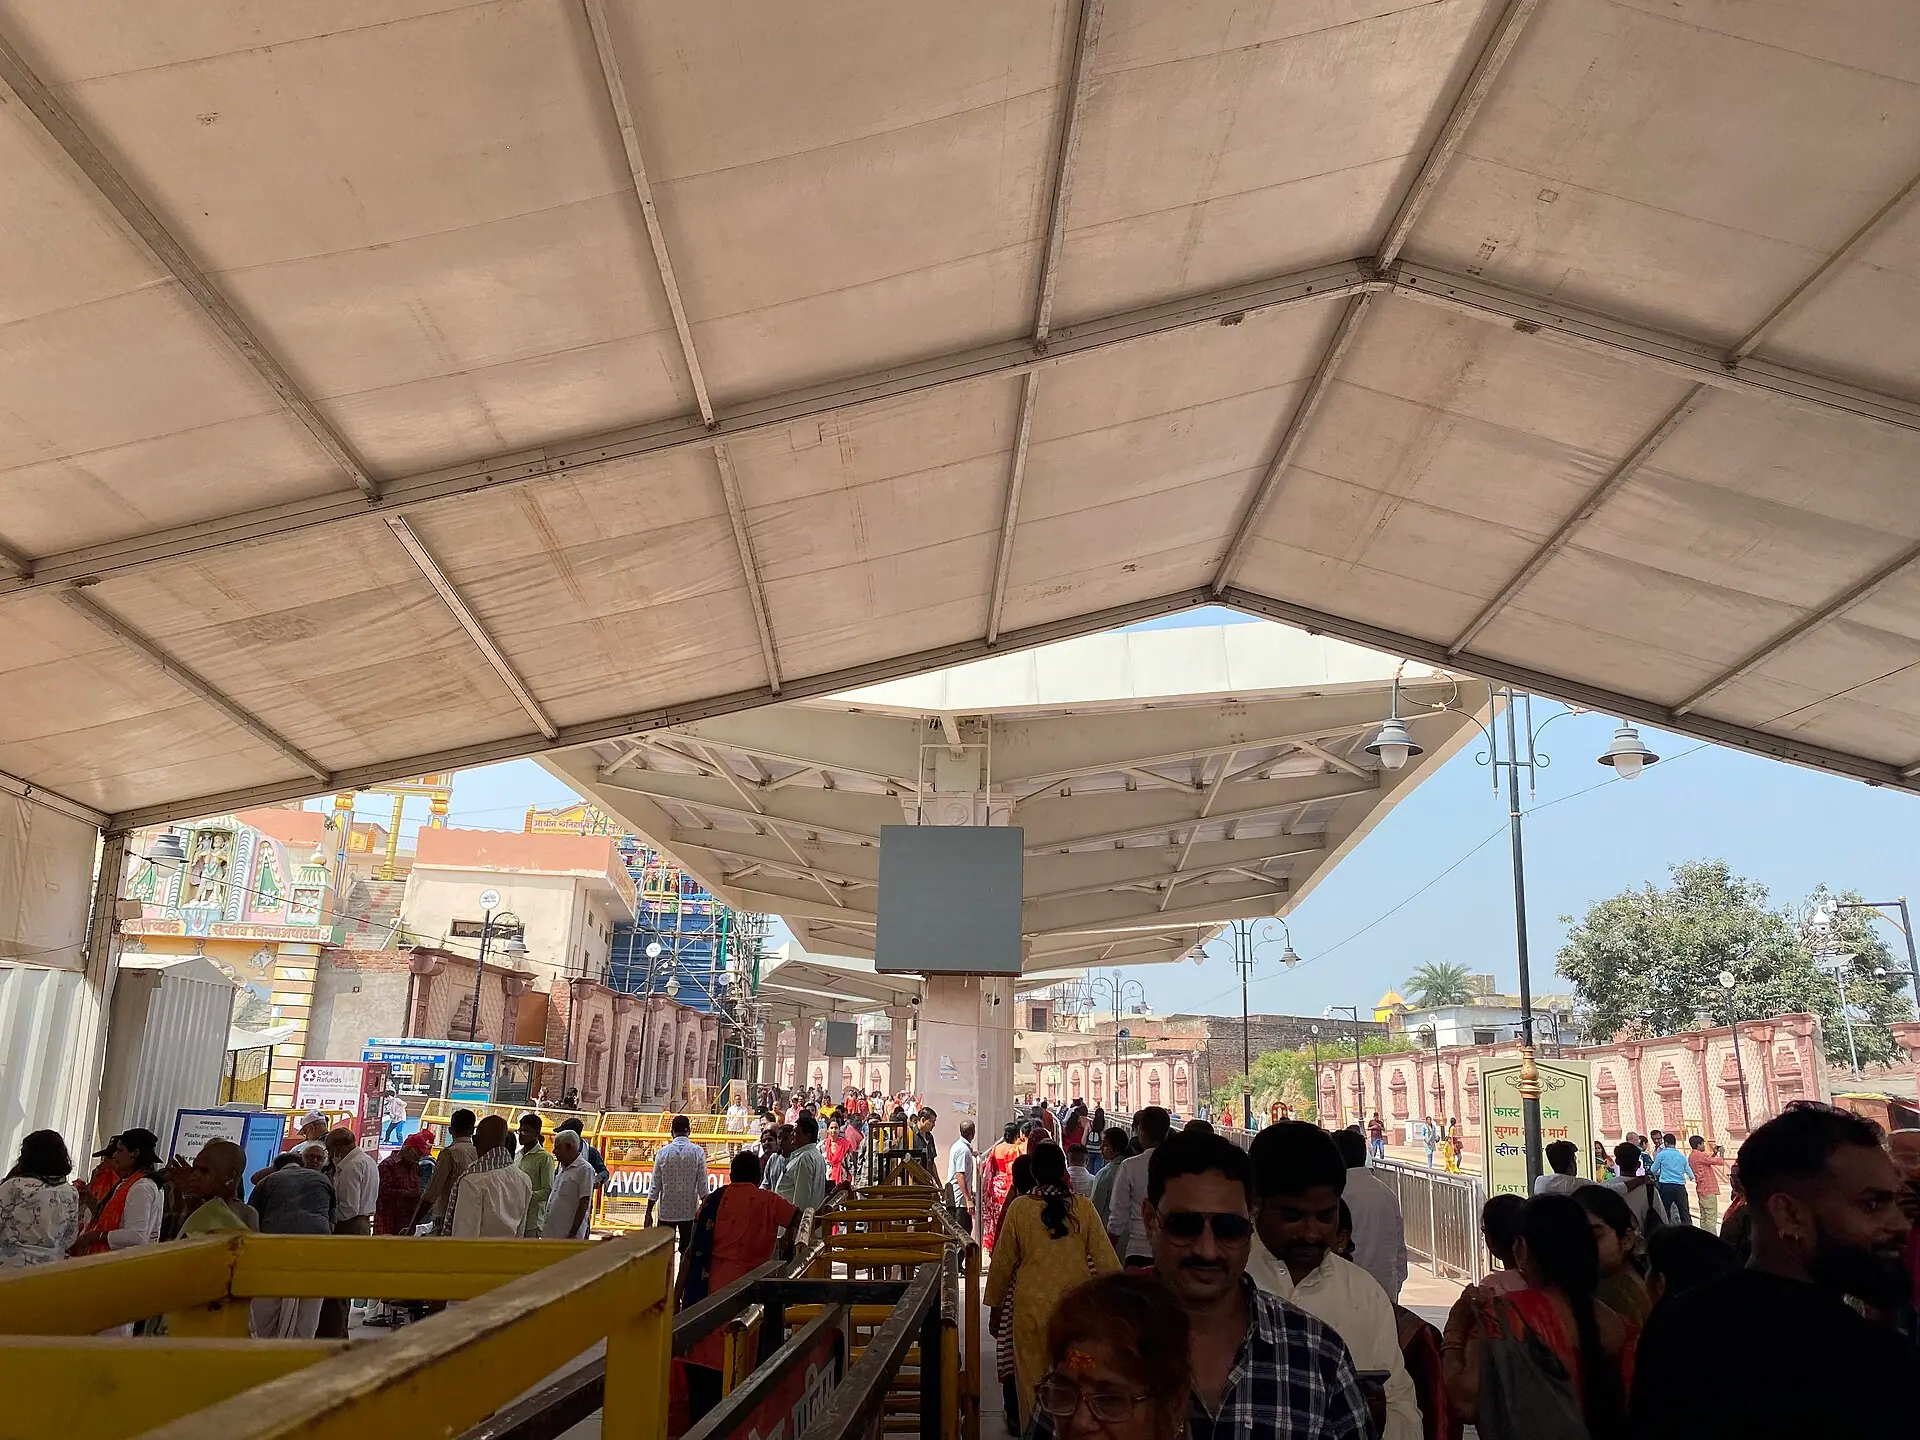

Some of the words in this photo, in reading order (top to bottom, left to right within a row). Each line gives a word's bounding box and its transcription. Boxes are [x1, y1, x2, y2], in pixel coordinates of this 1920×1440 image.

[473, 1056, 485, 1066] LIC
[1493, 1107, 1520, 1118] फास्ट
[1542, 1106, 1559, 1119] लेन
[1494, 1126, 1519, 1139] सुगम
[1548, 1125, 1568, 1138] मार्ग
[1494, 1143, 1519, 1156] व्हील
[607, 1171, 653, 1193] AYOD
[1496, 1184, 1518, 1193] FAST
